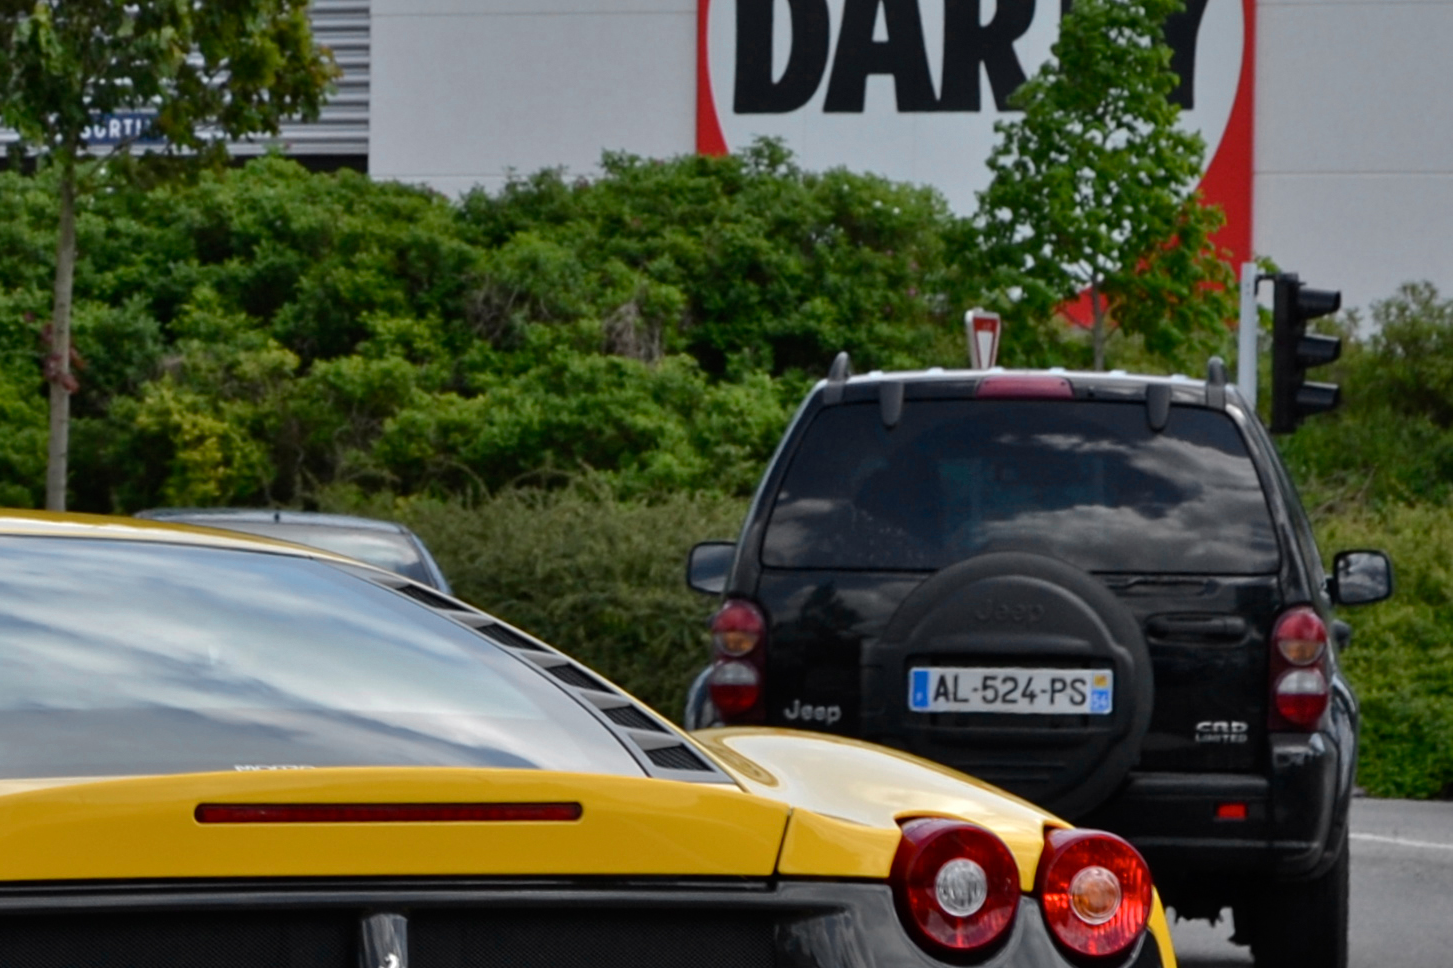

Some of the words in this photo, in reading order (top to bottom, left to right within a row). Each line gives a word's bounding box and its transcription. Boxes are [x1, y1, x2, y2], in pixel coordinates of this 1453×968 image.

[733, 0, 1209, 114] DARY
[974, 598, 1046, 623] Jeep
[933, 674, 1087, 706] AL-524-PS
[784, 699, 842, 725] Jeep
[1196, 721, 1249, 732] CRD
